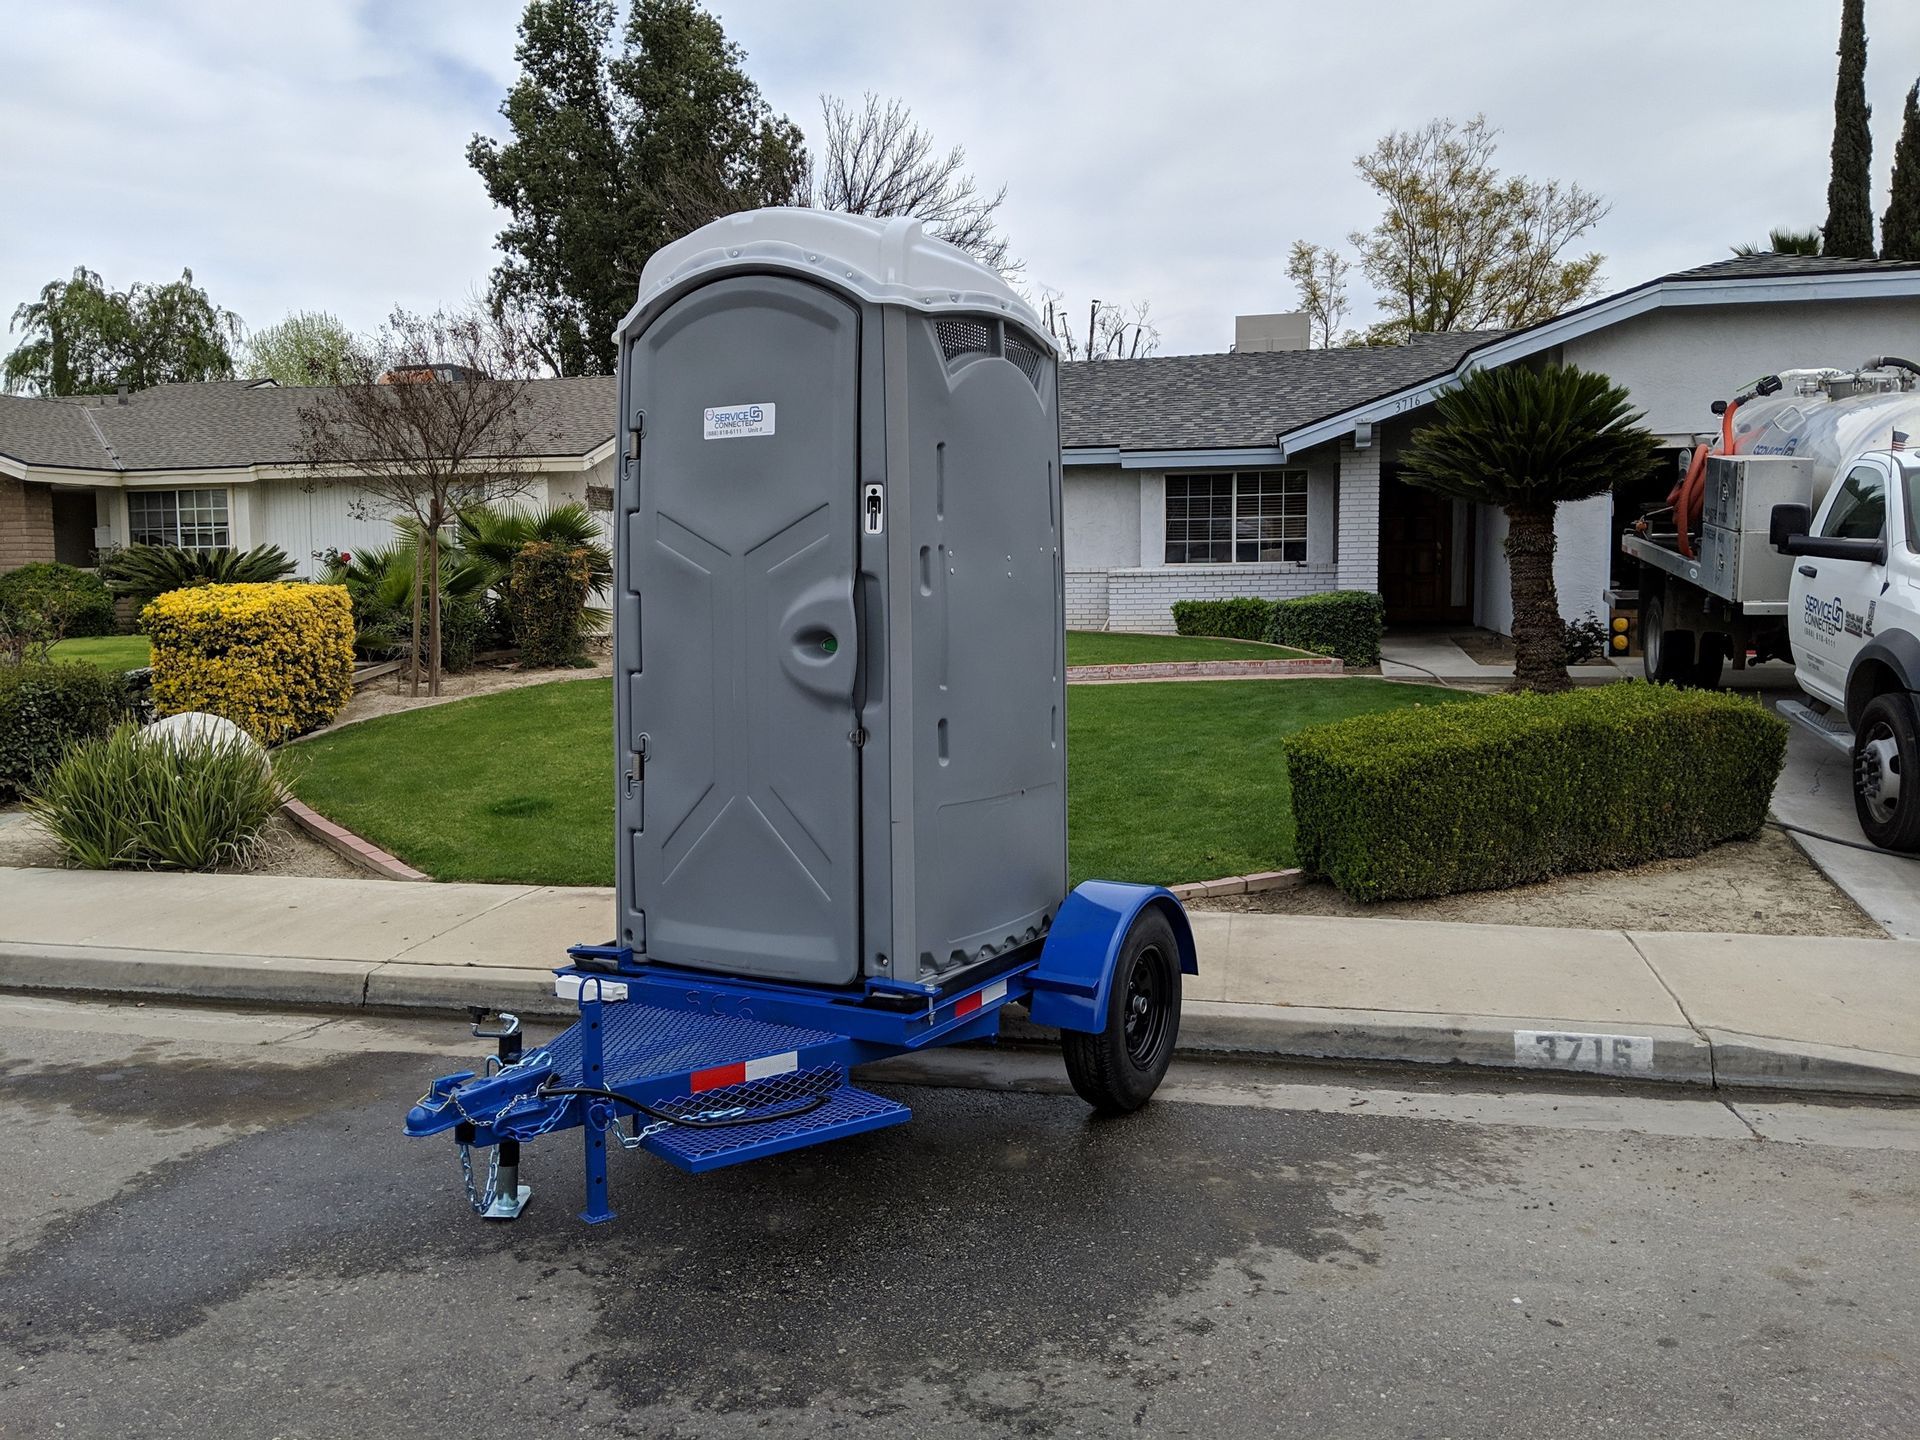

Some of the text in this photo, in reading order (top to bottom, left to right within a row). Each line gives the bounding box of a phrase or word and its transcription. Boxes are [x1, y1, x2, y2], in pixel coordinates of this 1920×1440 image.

[1395, 395, 1421, 413] 3716
[714, 411, 749, 422] SERVICE
[714, 420, 755, 429] CONNECTED
[1804, 594, 1832, 621] SERVICE
[1804, 611, 1836, 636] CONNECTED
[1536, 1034, 1633, 1072] 3716
